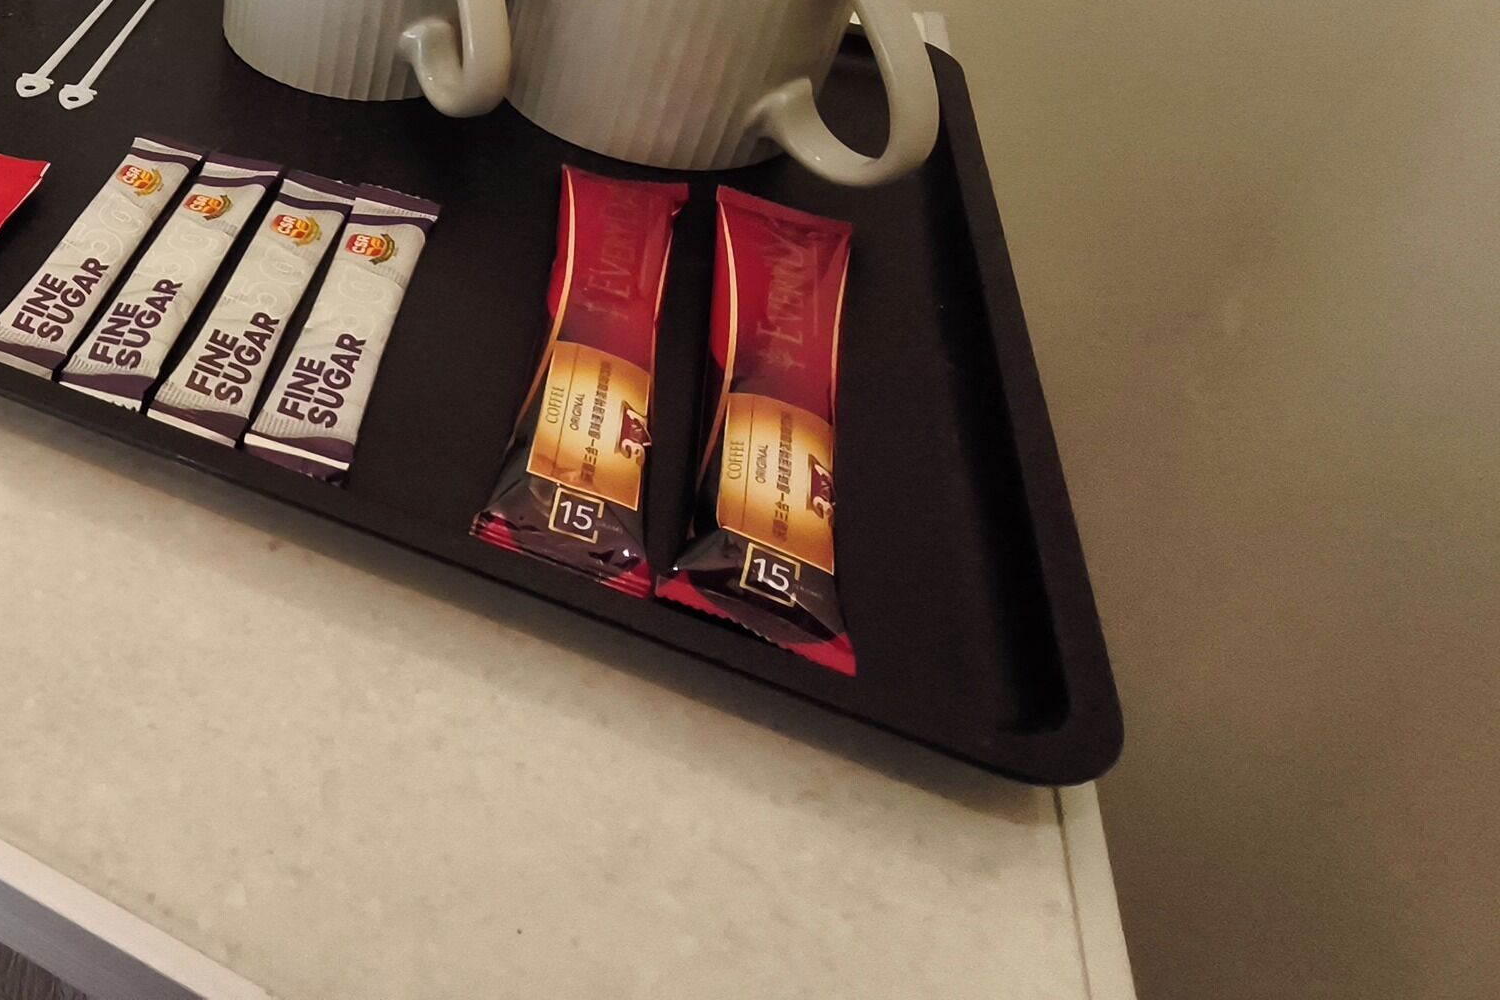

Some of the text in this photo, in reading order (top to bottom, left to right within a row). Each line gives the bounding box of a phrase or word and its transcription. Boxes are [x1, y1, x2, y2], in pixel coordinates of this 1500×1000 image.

[122, 166, 141, 184] CSR
[189, 195, 210, 211] CSR
[277, 216, 296, 234] CSR
[351, 235, 371, 253] CSR
[11, 273, 66, 335] FINE
[37, 256, 110, 343] SUGAR
[88, 301, 140, 365] FINE
[115, 278, 183, 369] SUGAR
[185, 328, 240, 396] FINE
[214, 311, 280, 405] SUGAR
[277, 356, 327, 420] FINE
[307, 333, 366, 429] SUGAR
[545, 386, 565, 424] COFFEE
[569, 393, 585, 431] ORIGINAL
[727, 440, 745, 480] COFFEE
[755, 444, 769, 485] ORIGINAL
[559, 501, 594, 530] 15
[753, 558, 791, 592] 15
